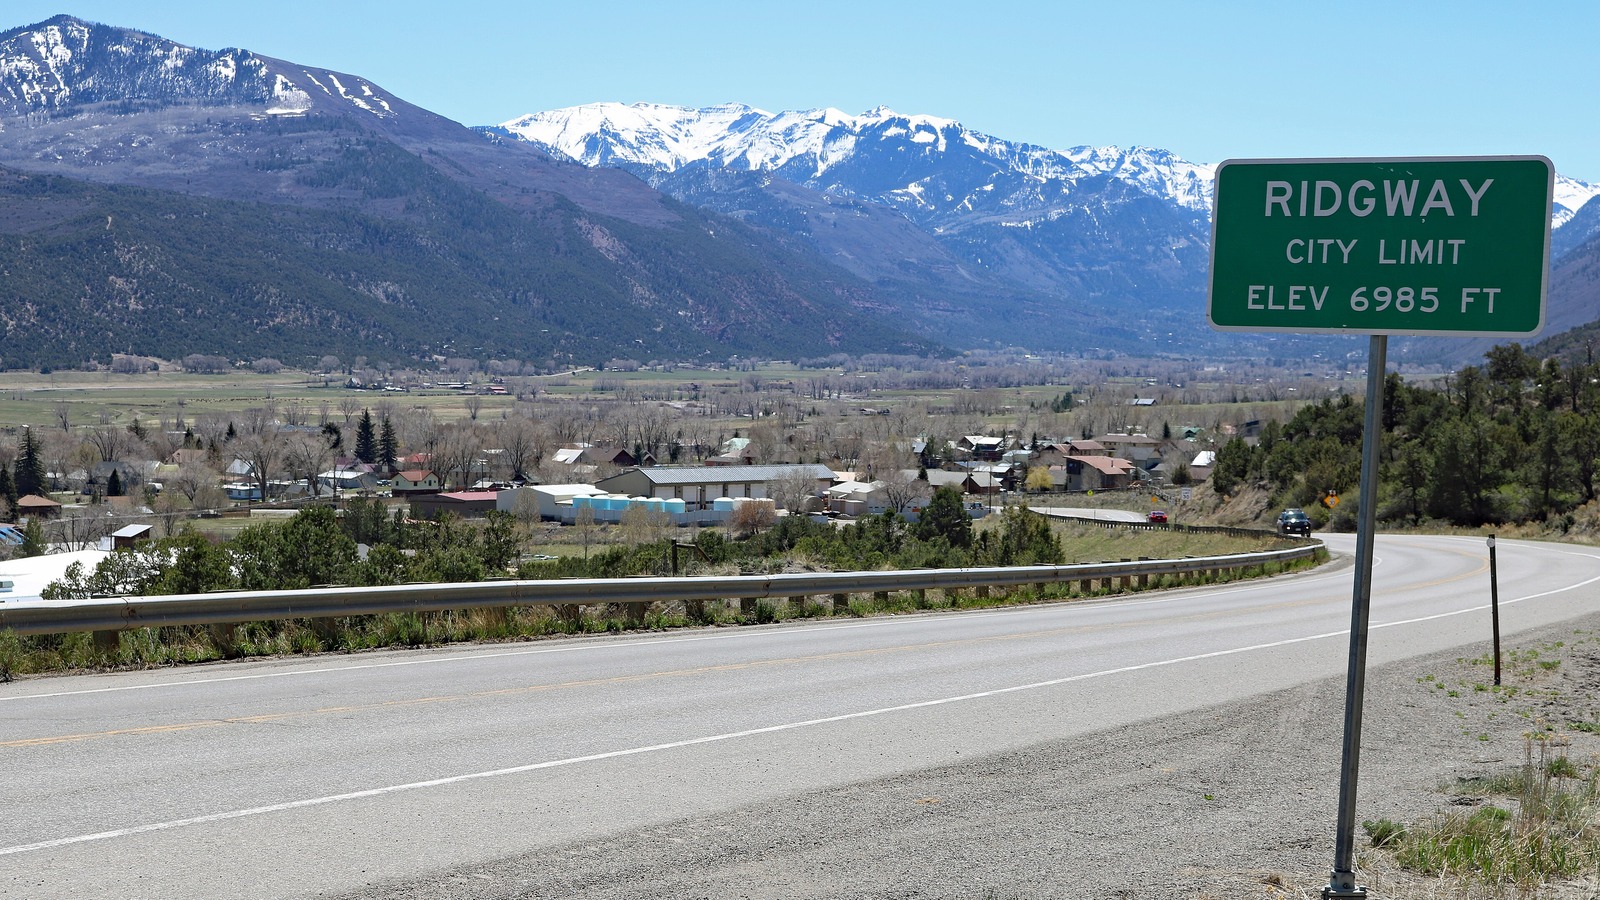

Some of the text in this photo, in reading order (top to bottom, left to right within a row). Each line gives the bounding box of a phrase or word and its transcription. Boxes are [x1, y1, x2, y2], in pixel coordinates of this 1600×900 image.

[1264, 178, 1495, 217] RIDGWAY
[1286, 238, 1466, 265] CITY LIMIT
[1247, 285, 1502, 314] ELEV 6985 FT
